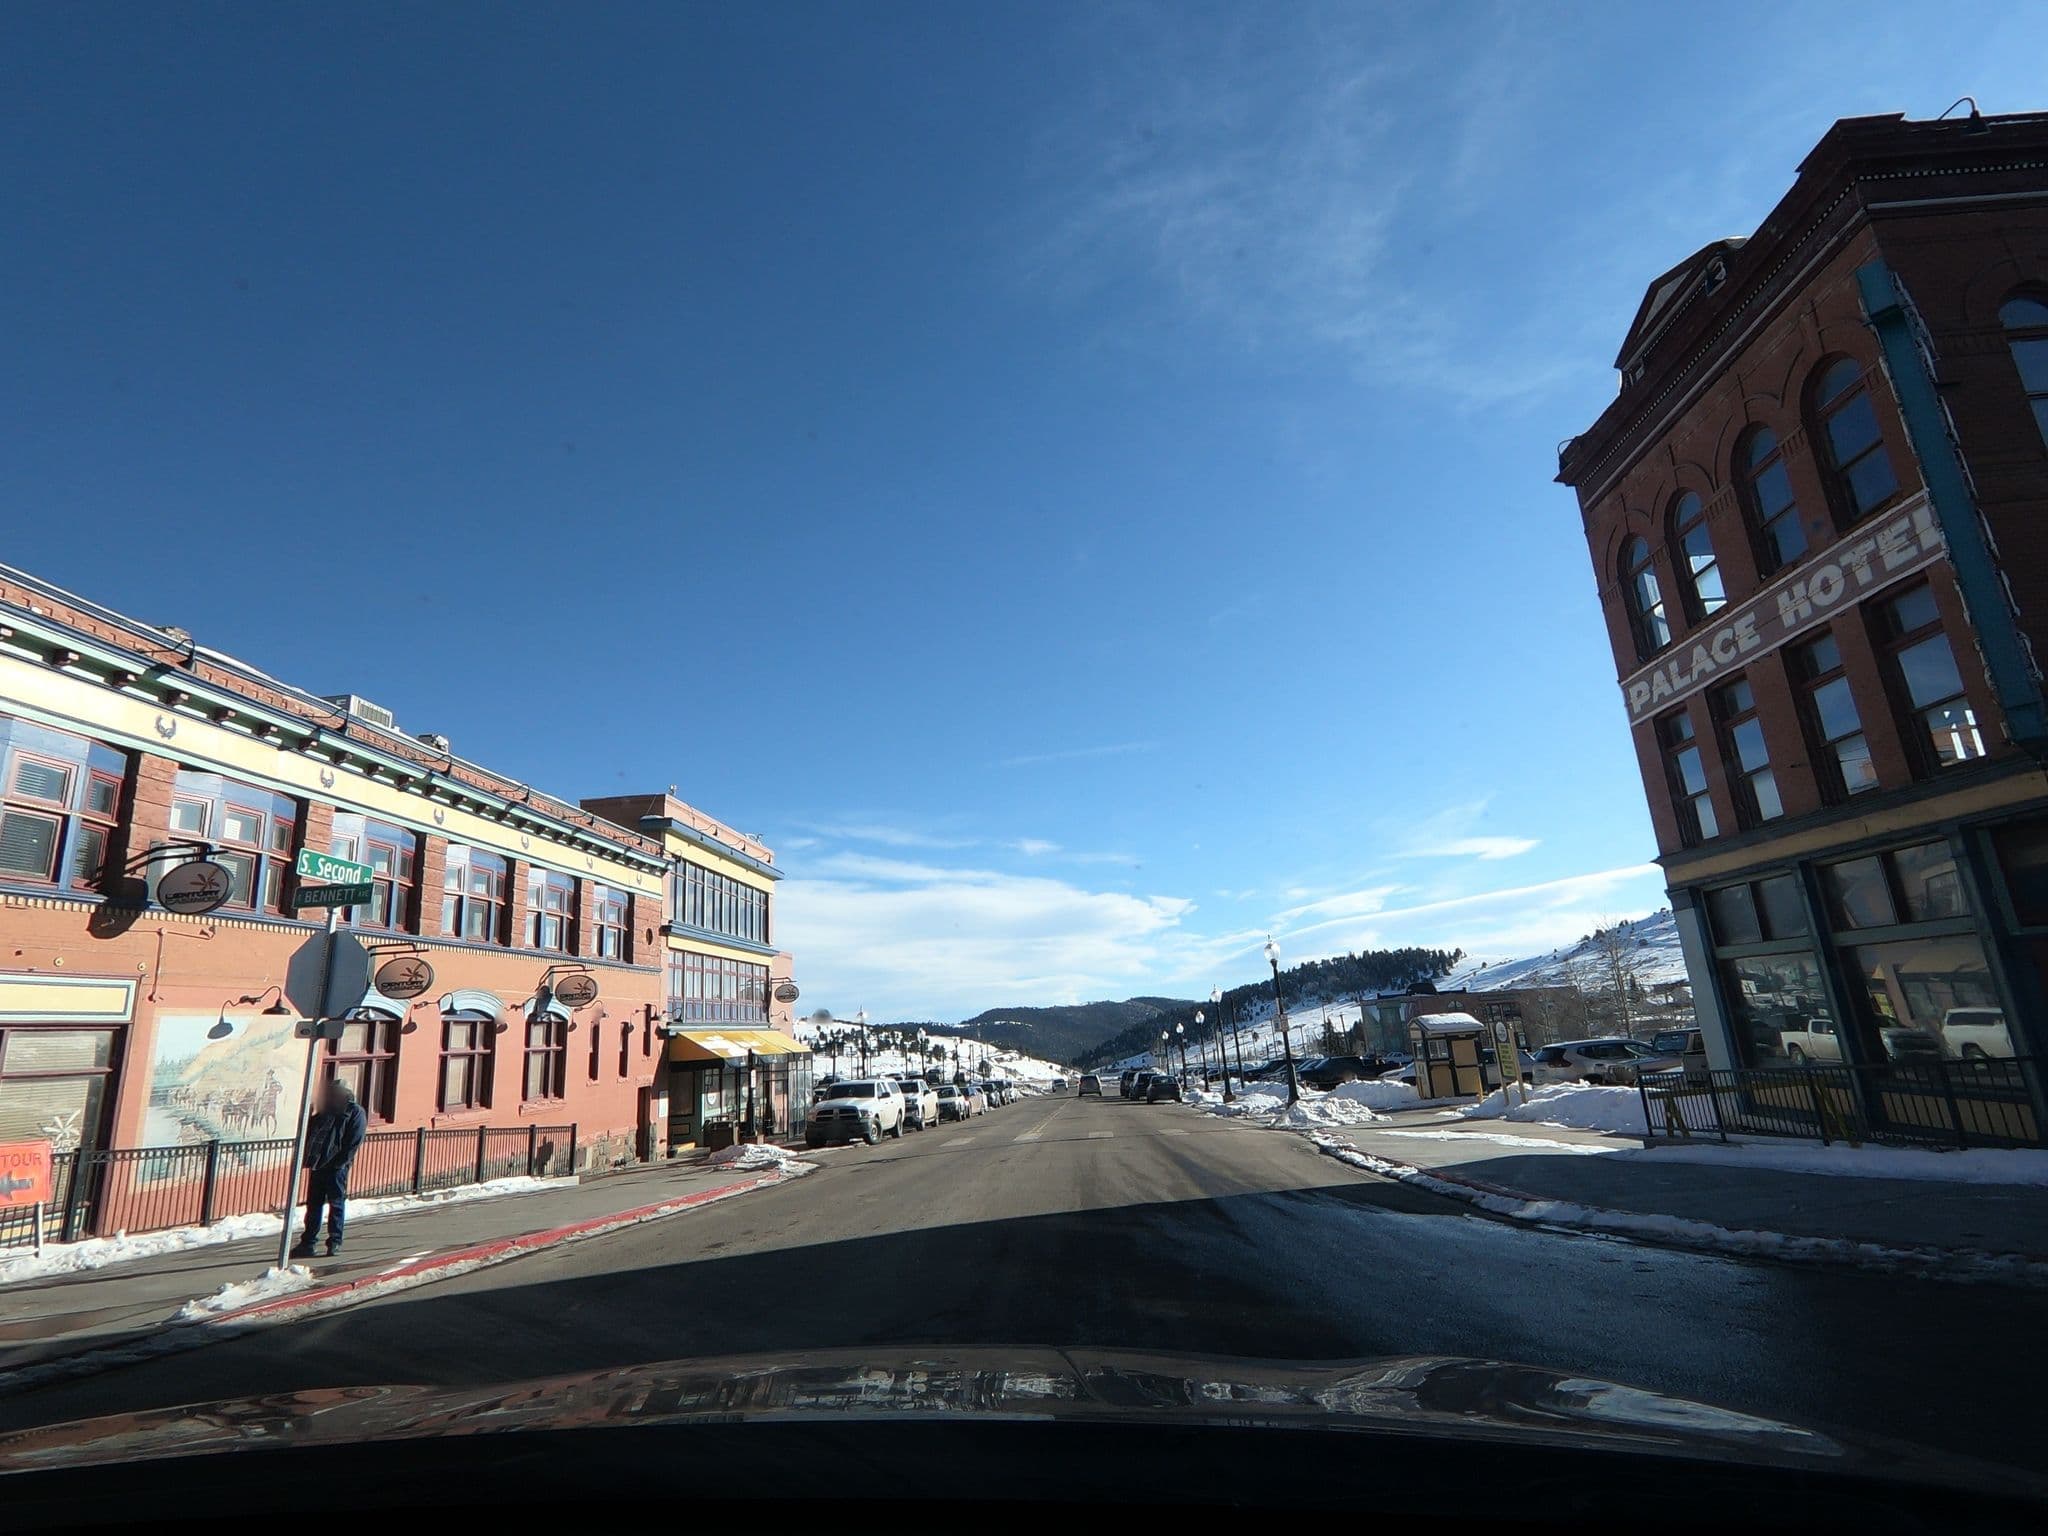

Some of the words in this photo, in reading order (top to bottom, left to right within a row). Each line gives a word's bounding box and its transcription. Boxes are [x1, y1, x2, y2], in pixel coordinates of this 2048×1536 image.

[1629, 612, 1761, 714] PALACE
[301, 853, 311, 873] S.
[316, 857, 361, 884] Second
[304, 889, 355, 903] BENNETT
